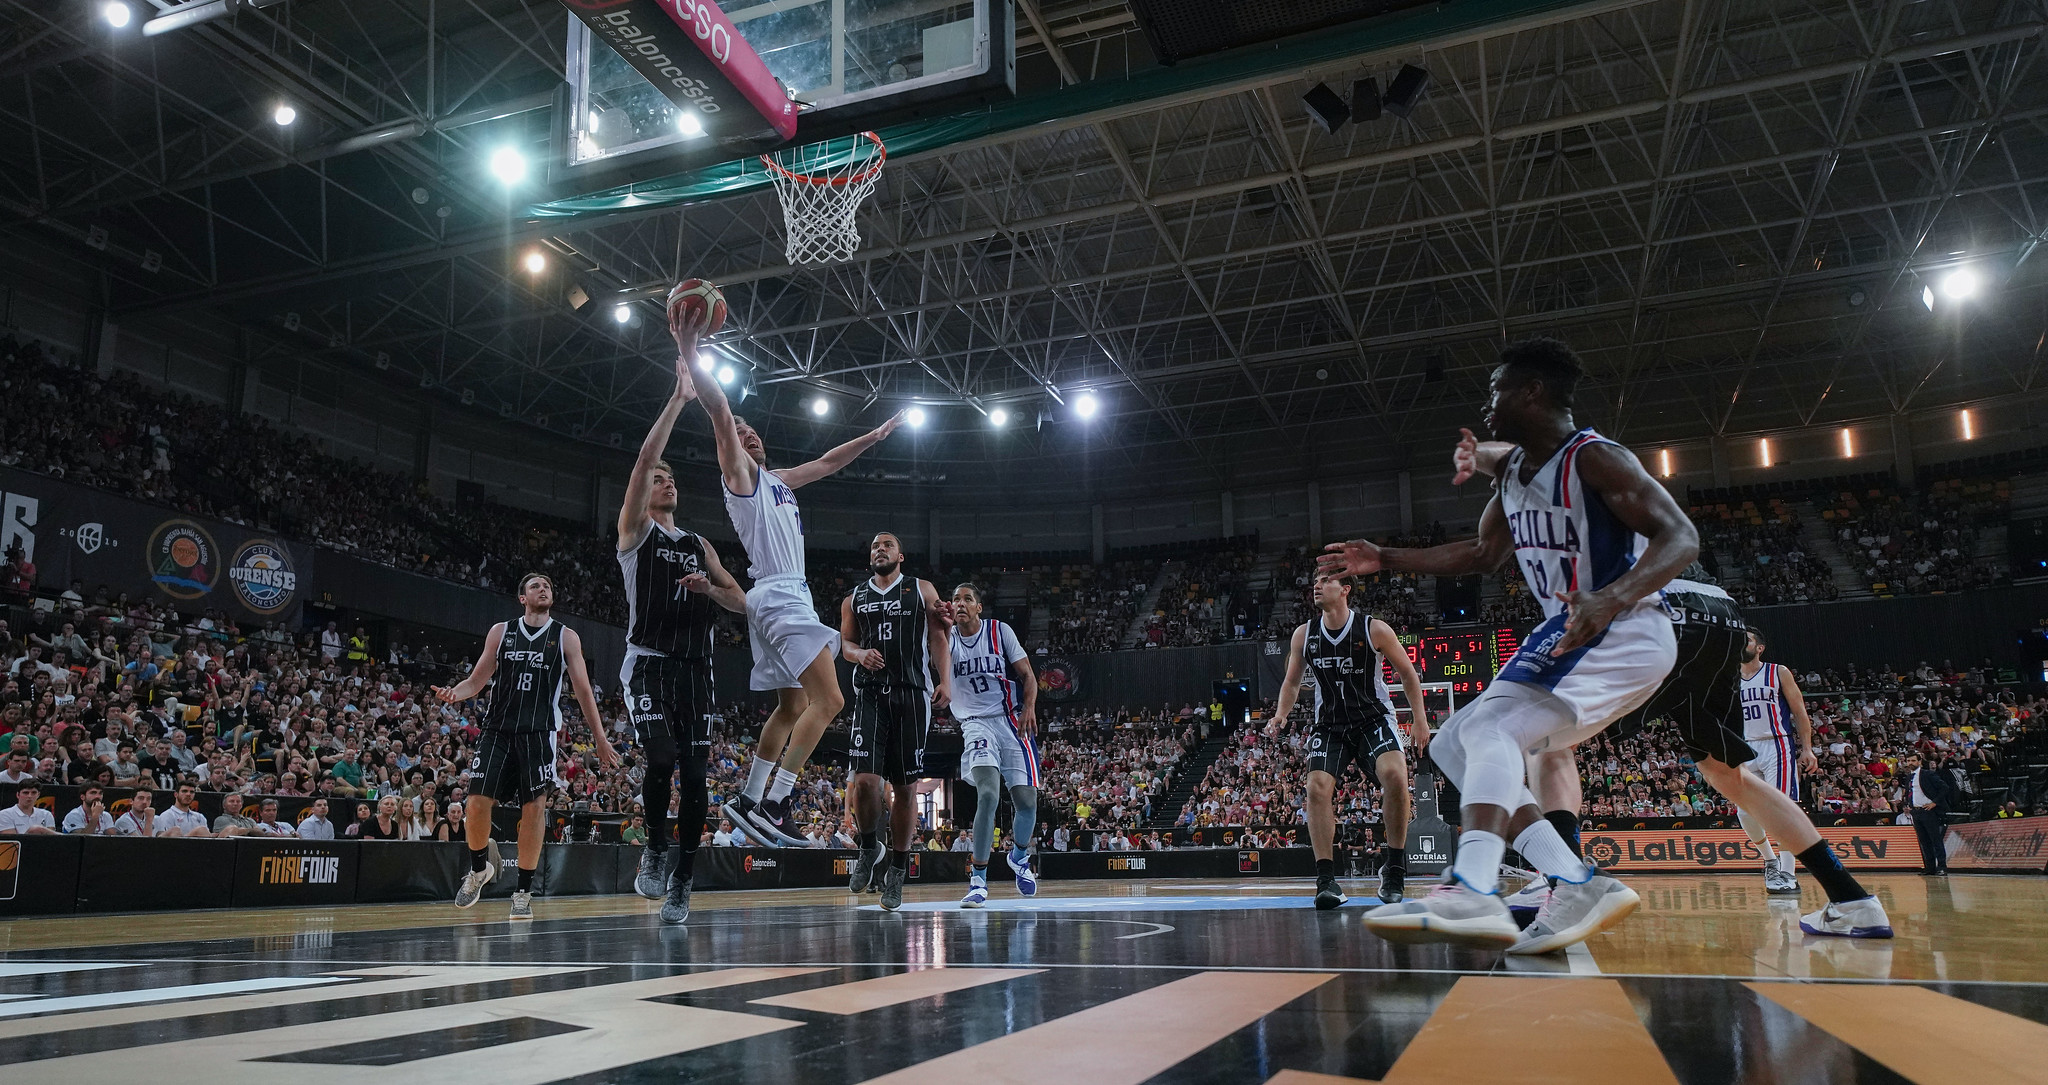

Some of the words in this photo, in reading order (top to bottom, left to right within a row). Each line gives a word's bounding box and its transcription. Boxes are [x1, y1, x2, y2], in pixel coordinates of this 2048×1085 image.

[591, 16, 638, 57] ESPAÑA
[252, 547, 274, 556] CLUB
[656, 547, 698, 570] RETA
[229, 567, 296, 591] OURENSE
[240, 583, 287, 607] BALONCESTO
[323, 592, 333, 602] 10
[857, 599, 902, 615] RETA
[877, 622, 892, 641] 13
[1435, 642, 1448, 653] 47
[1469, 641, 1482, 652] 51
[504, 651, 545, 666] RETA
[1455, 651, 1461, 660] 3
[1312, 656, 1354, 674] RETA
[1444, 664, 1473, 676] 03:01
[517, 672, 533, 691] 18
[969, 675, 989, 694] 13
[1462, 682, 1468, 692] 2
[1335, 680, 1345, 700] 7
[634, 712, 664, 725] Bilbao
[1742, 705, 1762, 721] 30
[1373, 726, 1384, 742] 7
[848, 748, 869, 758] Bilbao
[752, 858, 777, 868] baloncesto
[1408, 852, 1447, 861] LOTERÍAS
